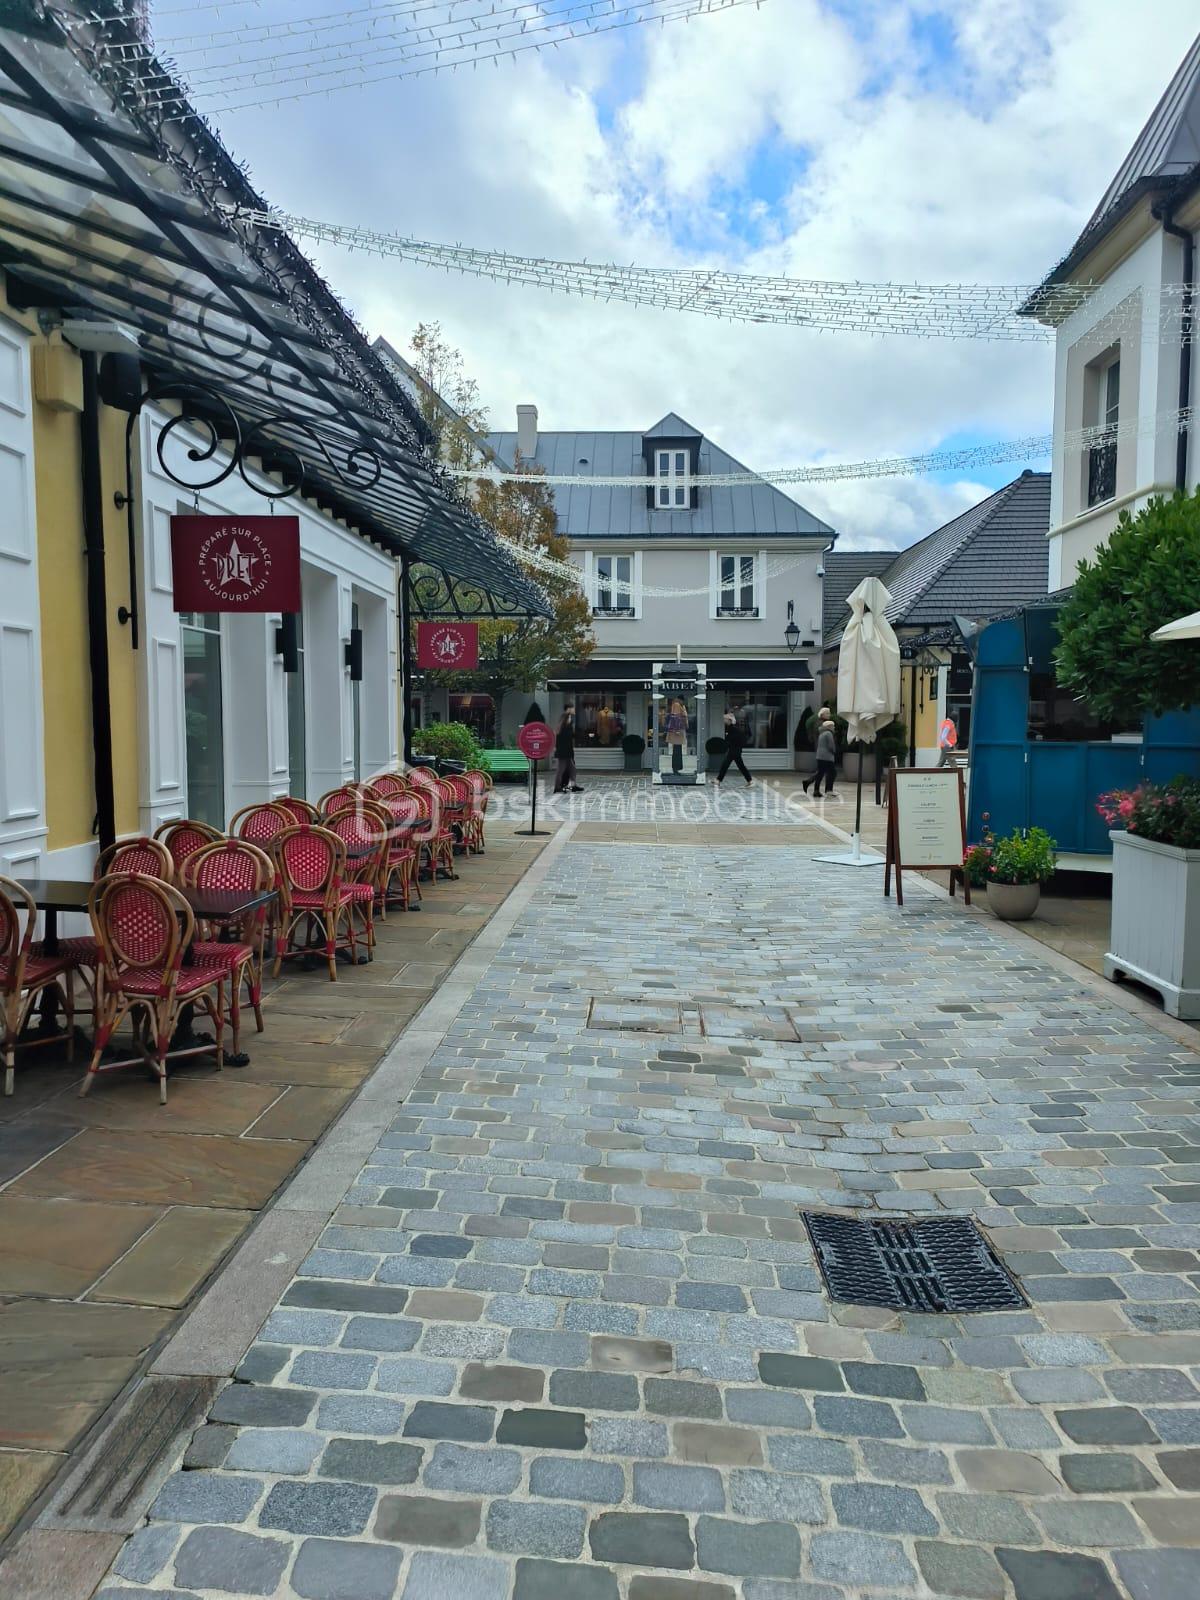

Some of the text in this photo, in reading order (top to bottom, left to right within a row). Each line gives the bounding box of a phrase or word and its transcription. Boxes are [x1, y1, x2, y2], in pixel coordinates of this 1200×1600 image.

[199, 527, 272, 567] PRÉPARÉ SUR PLACE
[215, 552, 255, 580] PRET
[203, 579, 269, 602] AUJOURD'HUI
[643, 682, 718, 690] BRBEY
